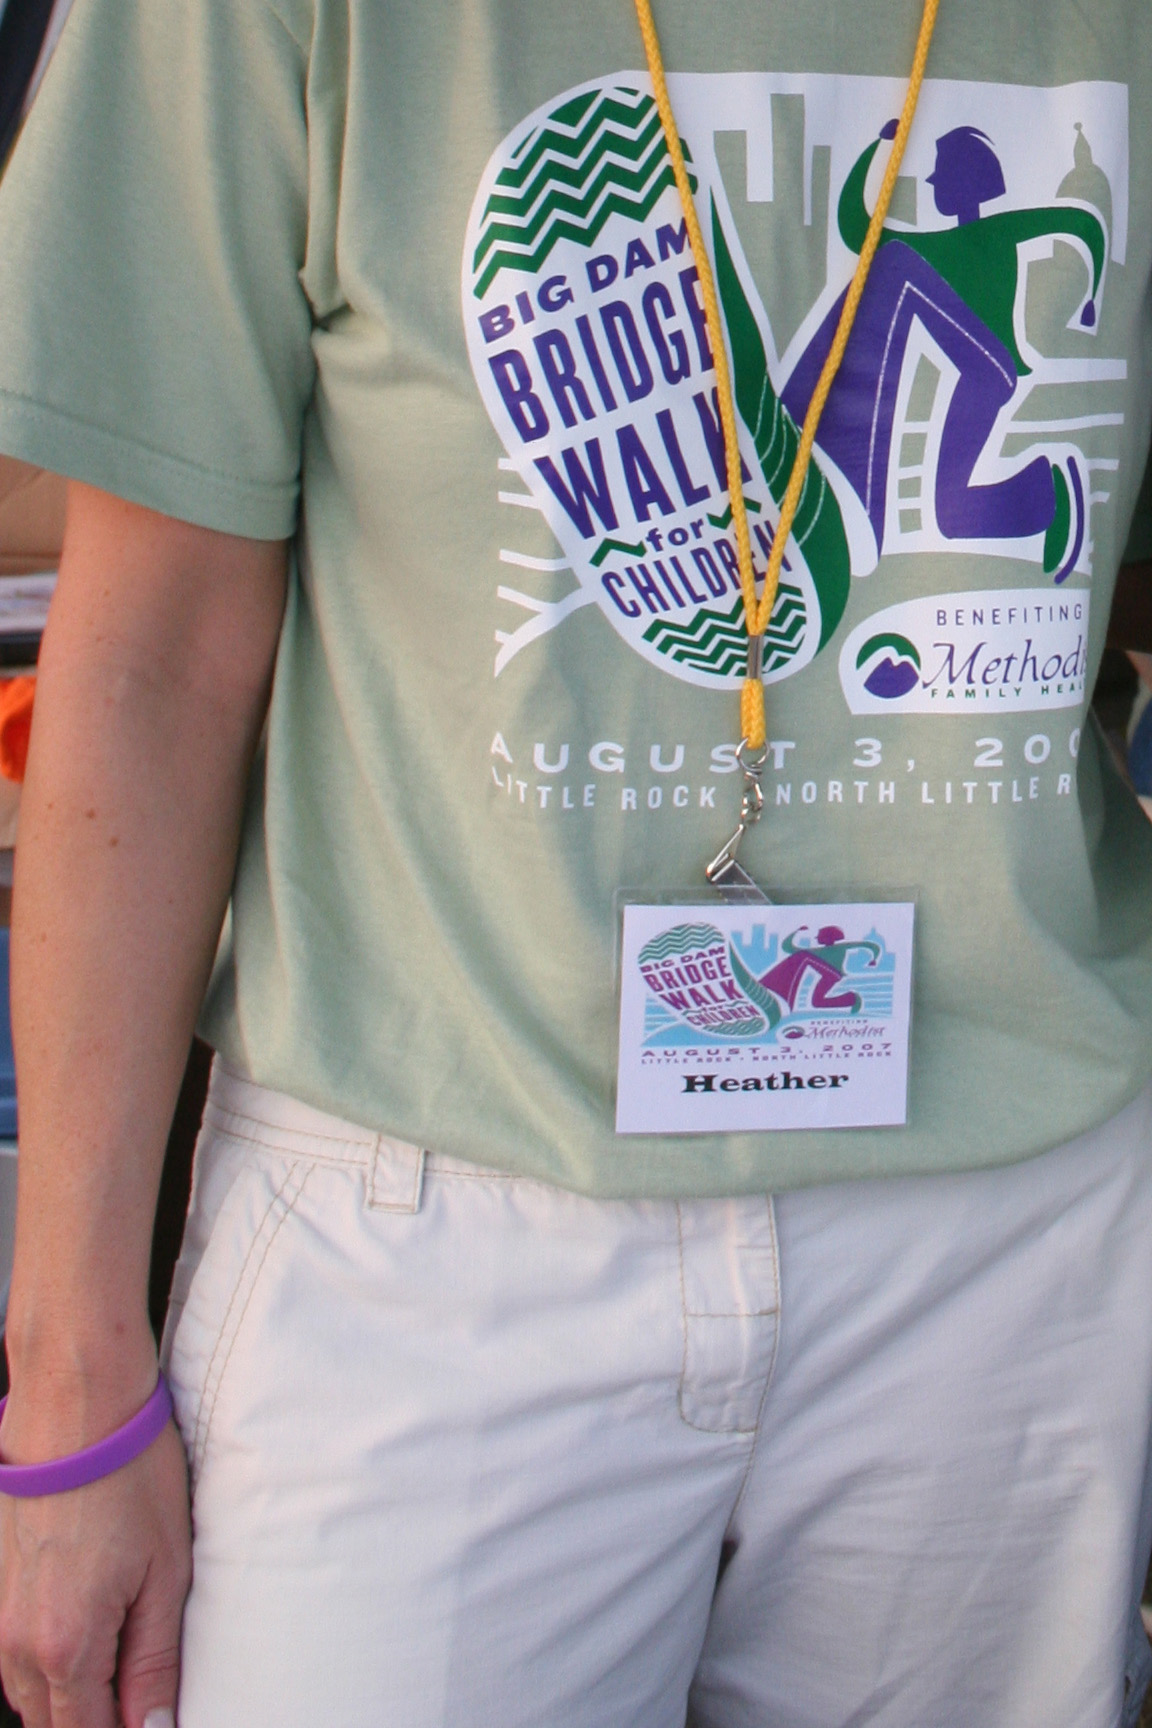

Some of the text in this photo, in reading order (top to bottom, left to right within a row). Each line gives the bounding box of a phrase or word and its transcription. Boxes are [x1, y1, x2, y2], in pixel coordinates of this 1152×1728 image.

[478, 216, 694, 344] BIG DAM
[488, 265, 716, 444] BRIDGE
[533, 385, 752, 540] WALK
[646, 519, 704, 552] for
[936, 603, 1083, 627] BENEFITING
[930, 687, 1023, 699] FAMILY
[490, 731, 797, 774] AUGUST
[491, 766, 597, 810] LITTLE
[620, 784, 717, 811] ROCK
[775, 779, 896, 806] NORTH
[921, 775, 1040, 805] LITTLE
[640, 946, 725, 973] BIG DAM
[643, 956, 731, 992] BRIDGE
[659, 978, 744, 1010] WALK
[686, 1005, 761, 1026] CHILDREN
[804, 1025, 886, 1039] Methodist
[641, 1047, 761, 1057] AUGUST
[822, 1042, 892, 1052] 2007
[681, 1071, 850, 1093] Heather
